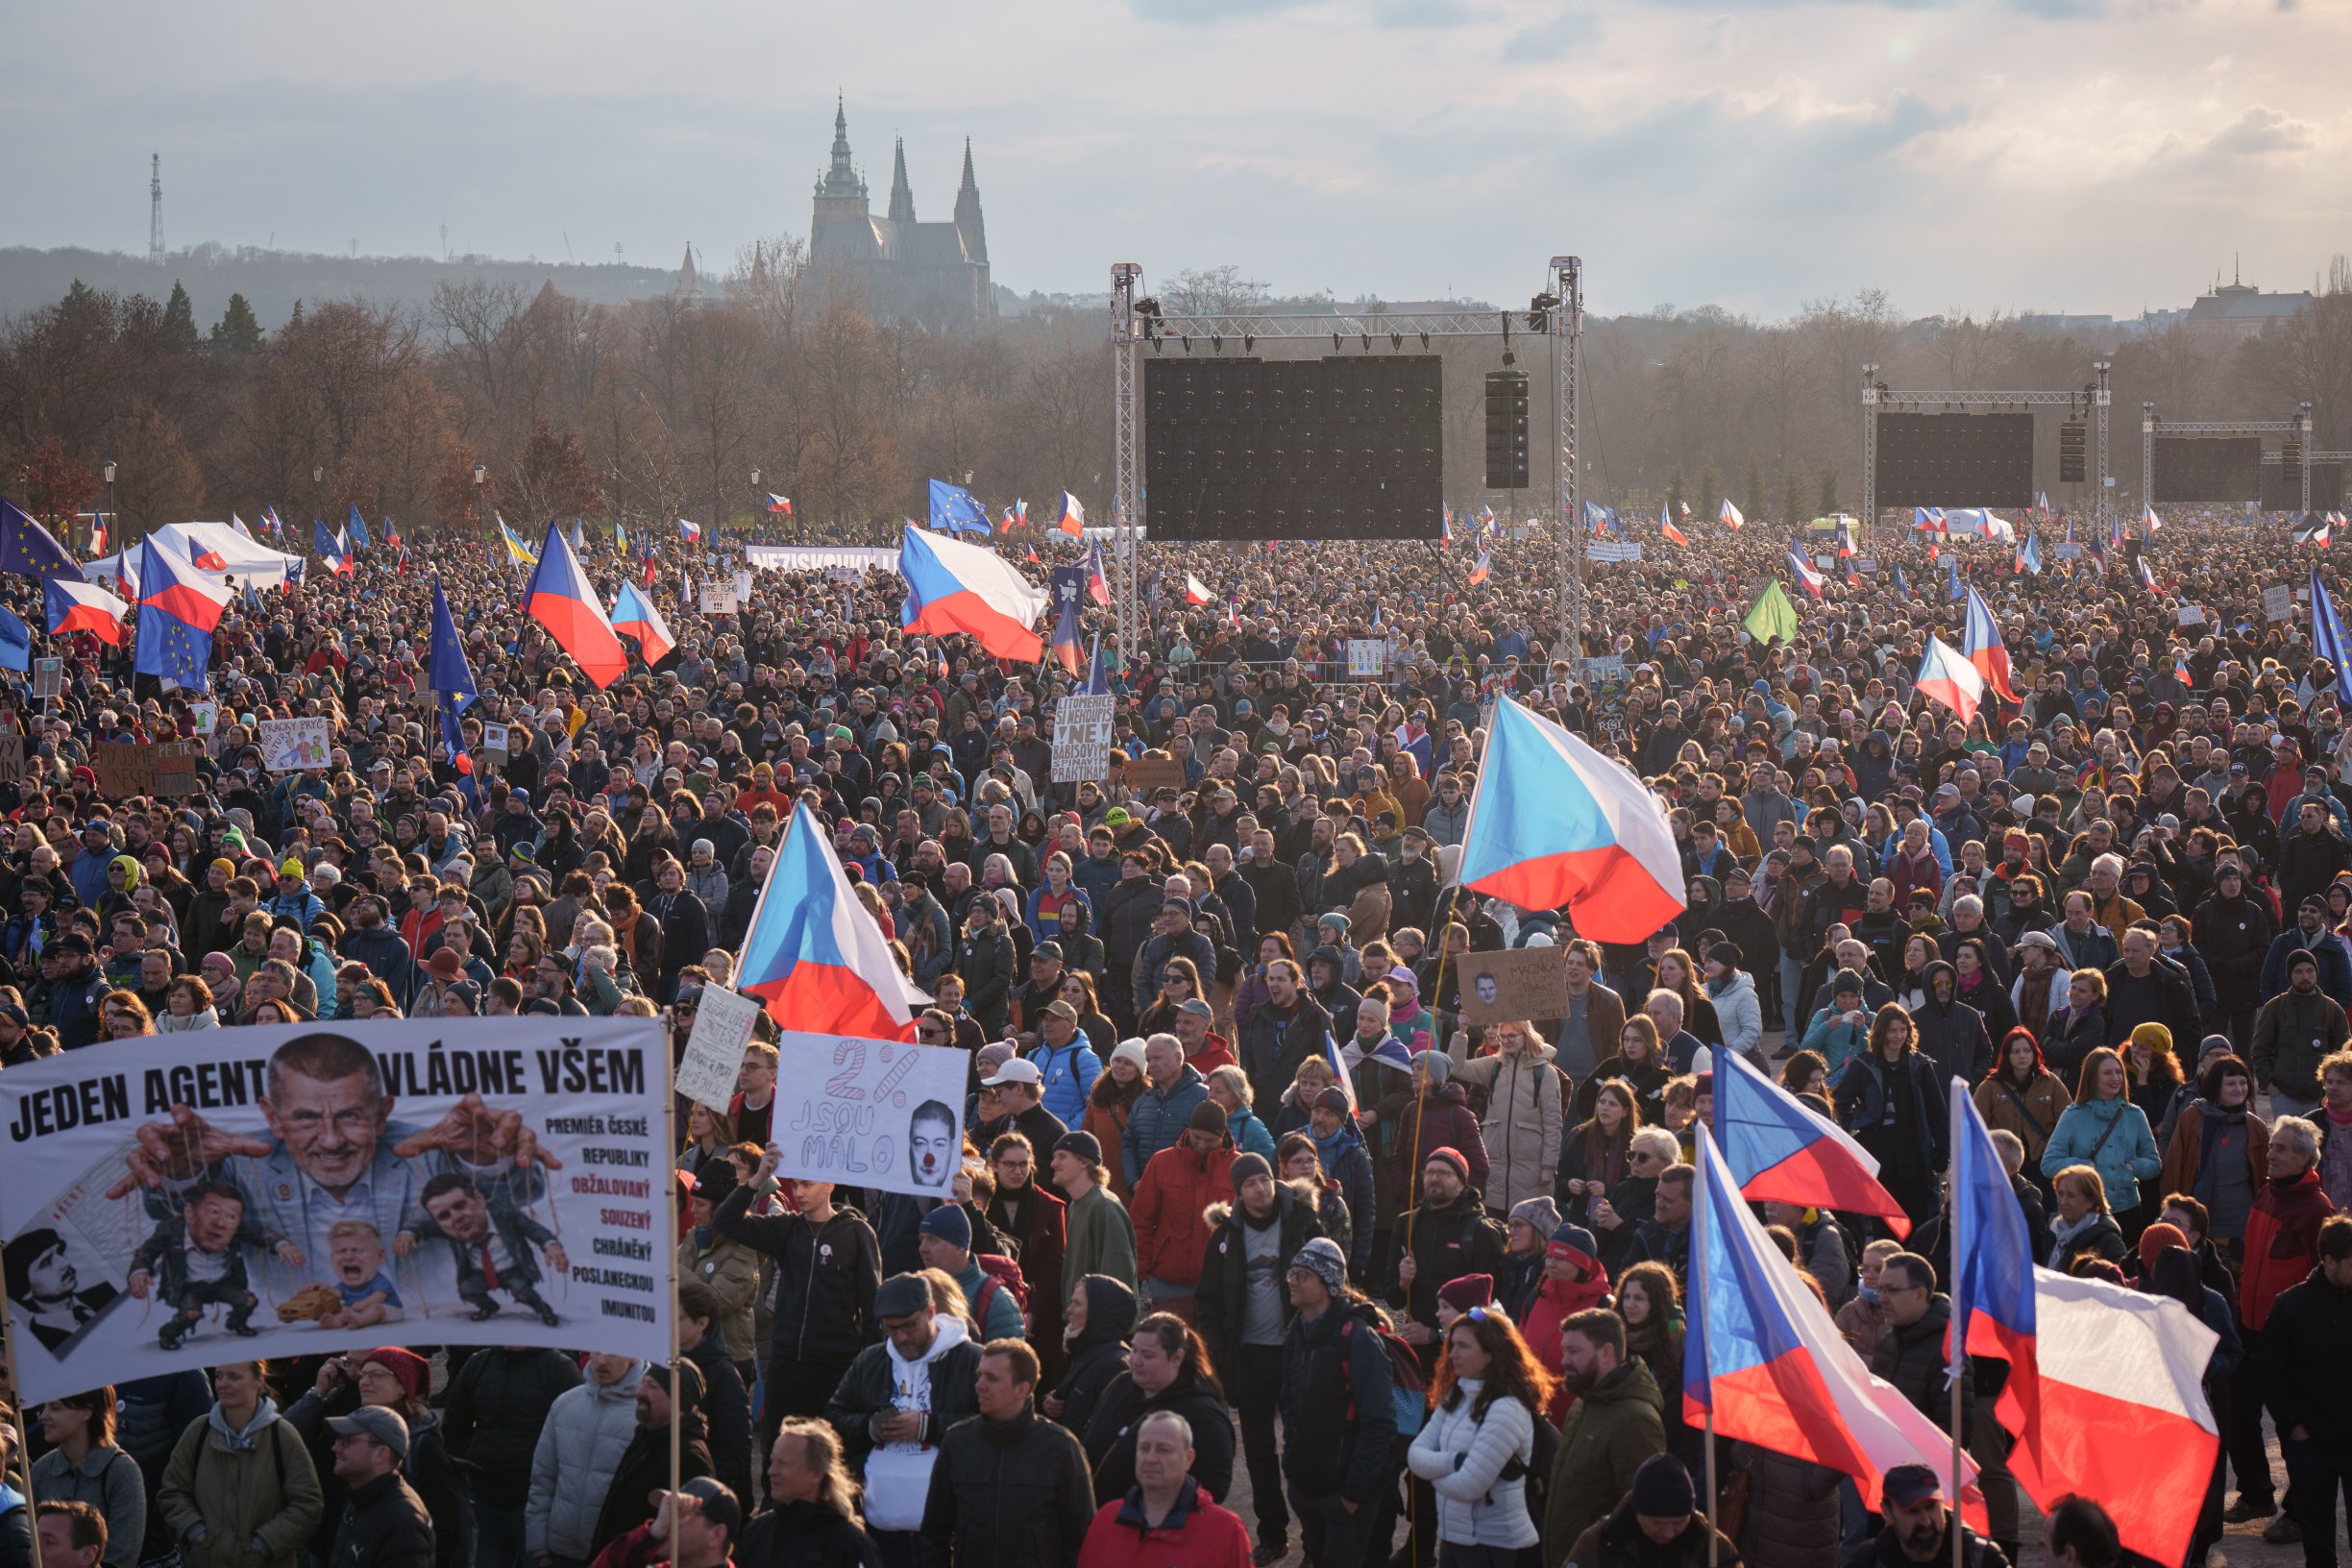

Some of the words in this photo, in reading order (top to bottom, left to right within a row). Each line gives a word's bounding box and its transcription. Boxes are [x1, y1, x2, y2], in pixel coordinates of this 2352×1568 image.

[707, 593, 729, 601] DOST
[261, 721, 297, 735] PRACKY
[300, 718, 324, 730] PRYČ
[10, 1073, 131, 1142] JEDEN
[145, 1059, 267, 1115] AGENT
[377, 1039, 527, 1097] VLÁDNE
[536, 1037, 645, 1094] VŠEM
[546, 1115, 605, 1135] PREMIÉR
[607, 1115, 649, 1137] ČESKÉ
[791, 1100, 874, 1136] JSOU
[582, 1147, 649, 1167] REPUBLIKY
[572, 1173, 650, 1200] OBŽALOVANÝ
[600, 1208, 651, 1231] SOUZENÝ
[593, 1237, 652, 1262] CHRÁNĚNÝ
[573, 1266, 654, 1293] POSLANECKOU
[601, 1299, 655, 1324] IMUNITOU
